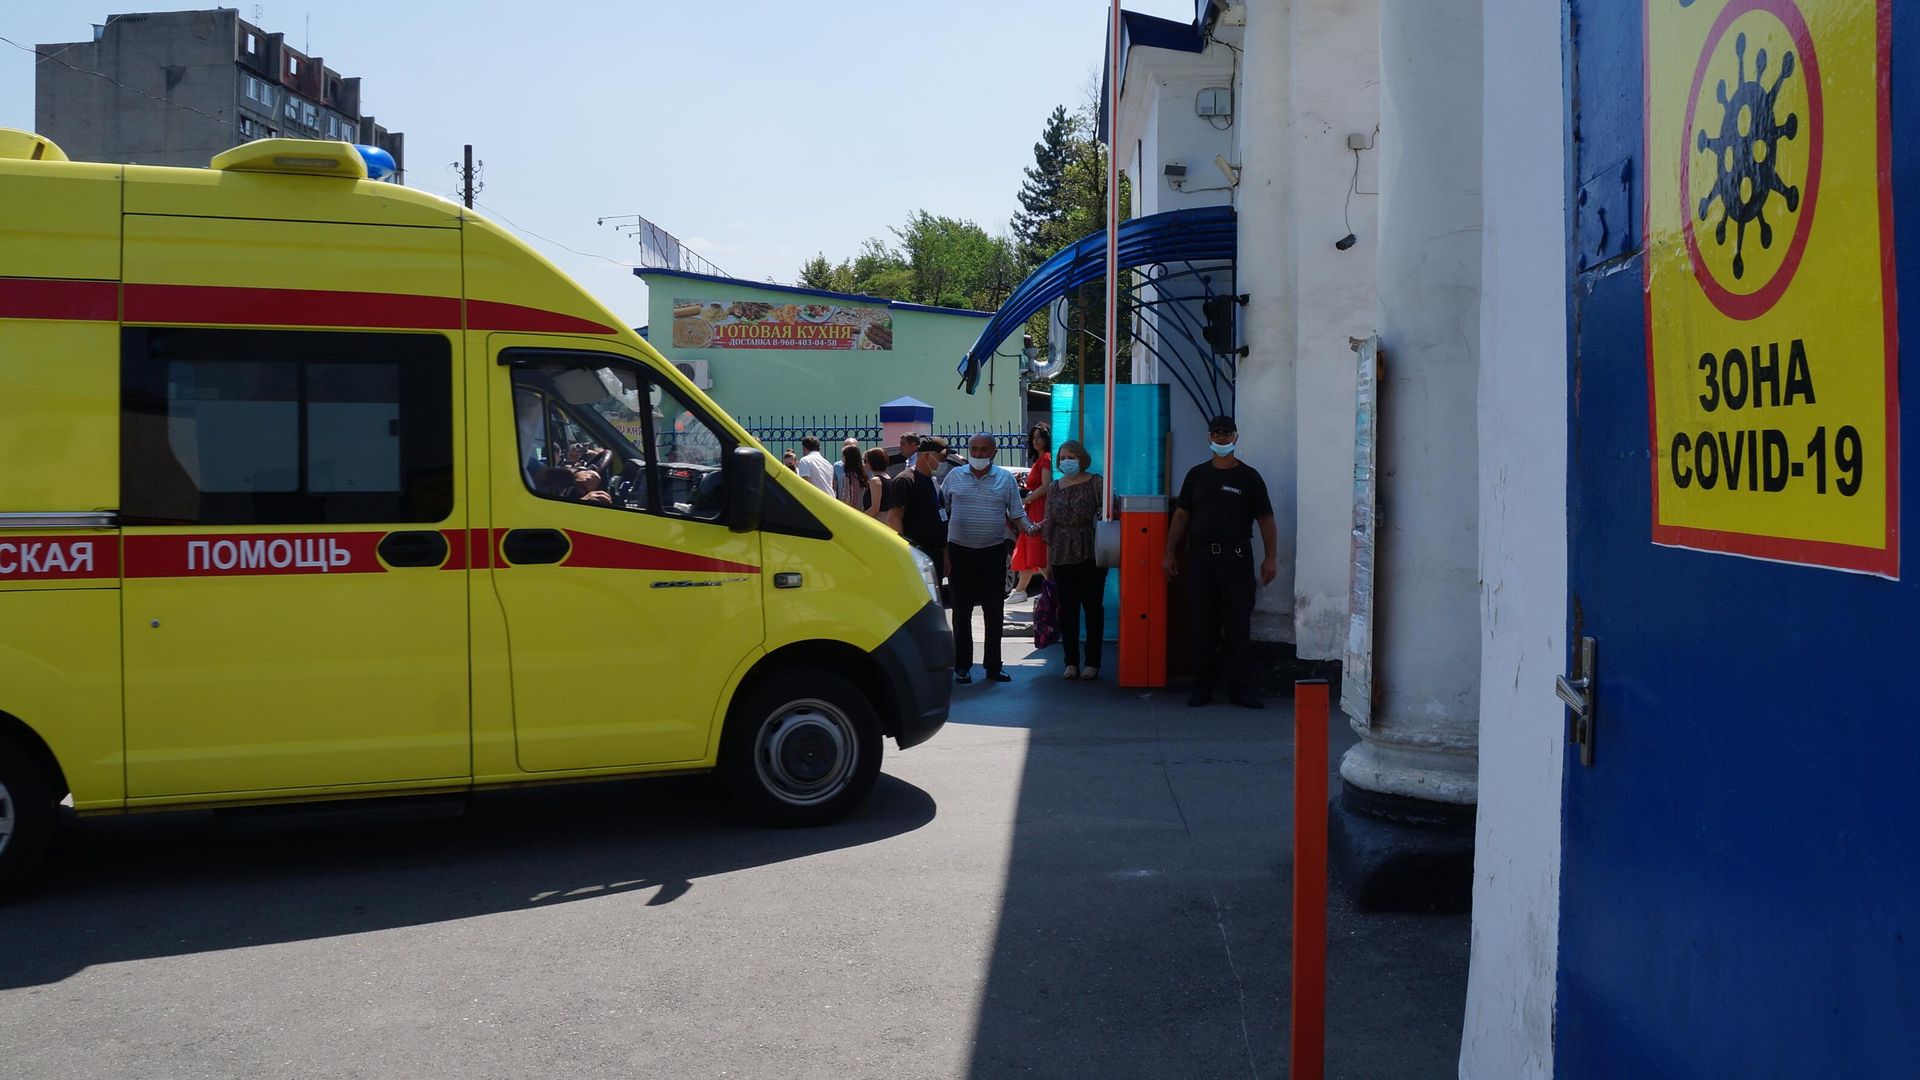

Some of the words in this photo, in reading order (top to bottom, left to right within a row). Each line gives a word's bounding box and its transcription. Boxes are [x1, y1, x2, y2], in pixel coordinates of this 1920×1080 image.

[719, 324, 792, 339] ГОТОВАЯ
[797, 324, 851, 339] КУХНЯ
[729, 338, 771, 347] ДОСТАВКА
[773, 338, 838, 347] 8-960-403-04-58
[1697, 338, 1817, 413] ЗОНА
[1671, 424, 1863, 497] COVID-19
[187, 538, 351, 573] ПОМОЩЬ
